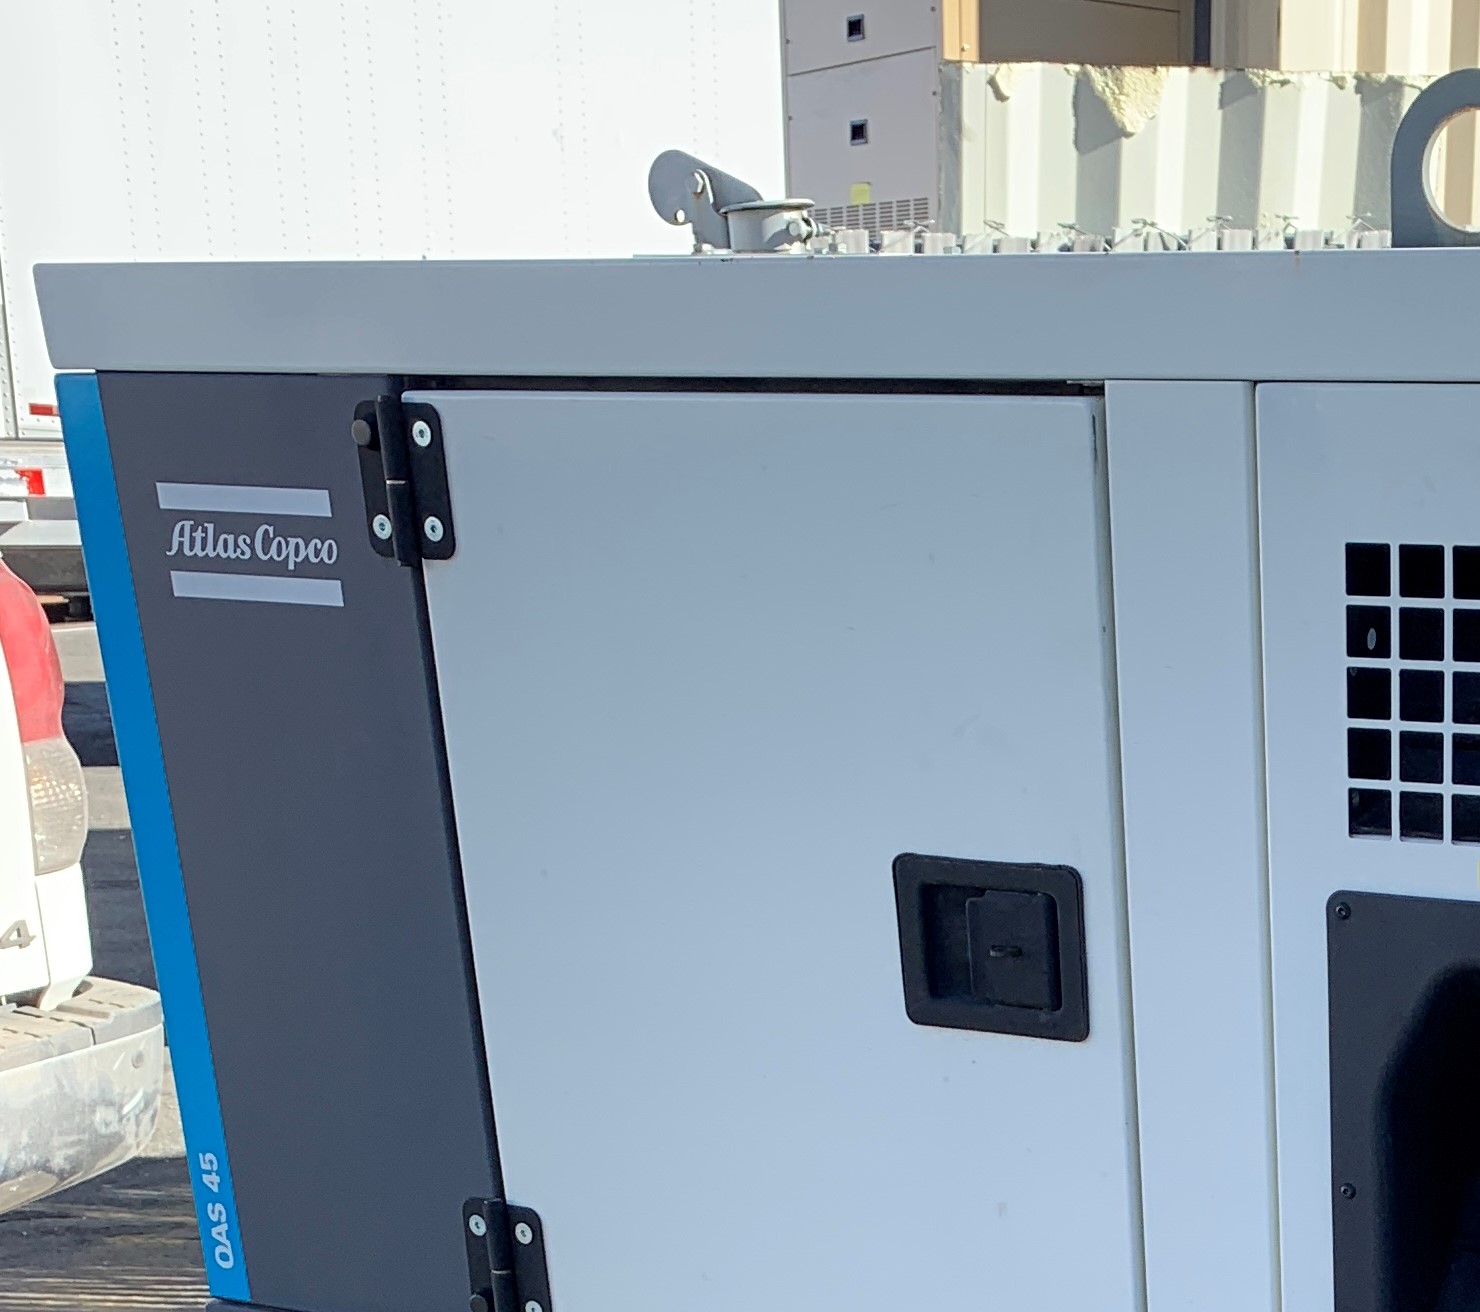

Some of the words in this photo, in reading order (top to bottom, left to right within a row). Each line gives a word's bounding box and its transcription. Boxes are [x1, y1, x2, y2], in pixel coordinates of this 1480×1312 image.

[166, 520, 251, 560] Atlas
[254, 524, 338, 570] Copco
[198, 1152, 221, 1193] 45
